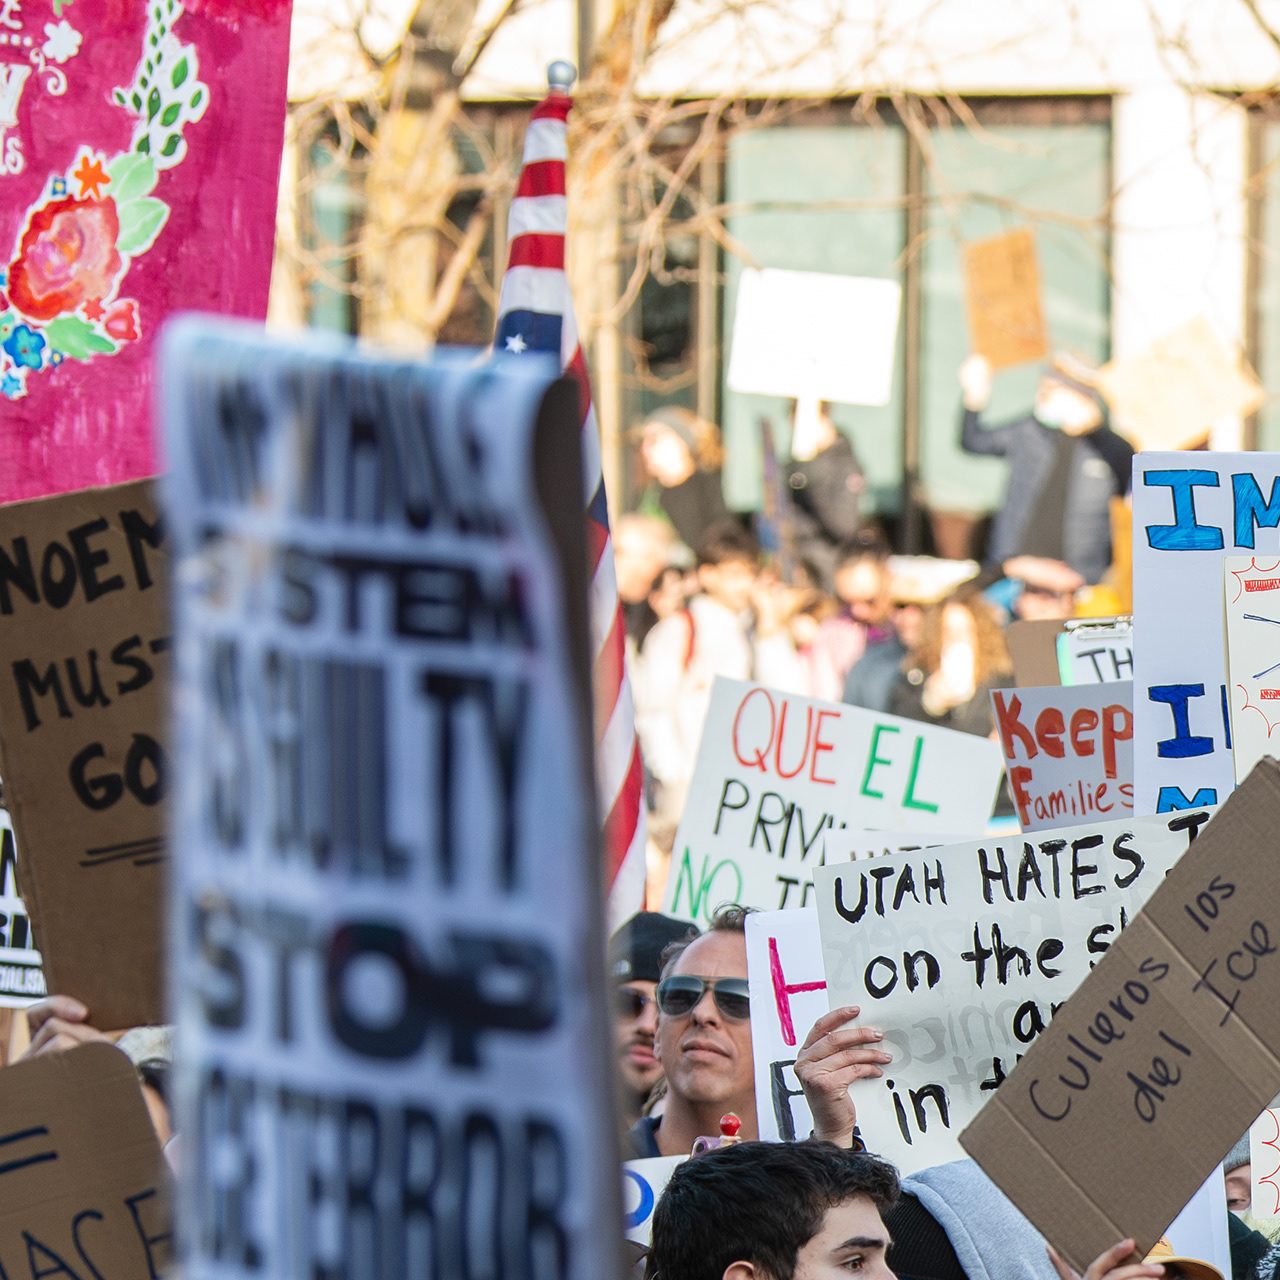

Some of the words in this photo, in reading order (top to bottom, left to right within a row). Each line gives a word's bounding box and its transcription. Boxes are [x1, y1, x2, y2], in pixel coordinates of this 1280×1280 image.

[11, 633, 172, 733] MUS
[731, 686, 843, 786] QUE
[857, 722, 939, 815] EL
[992, 690, 1134, 780] Keep
[1008, 765, 1134, 827] Families
[833, 857, 949, 926] UTAH
[976, 833, 1147, 906] HATES
[862, 948, 942, 1000] on
[960, 920, 1066, 991] the
[885, 1079, 951, 1146] in
